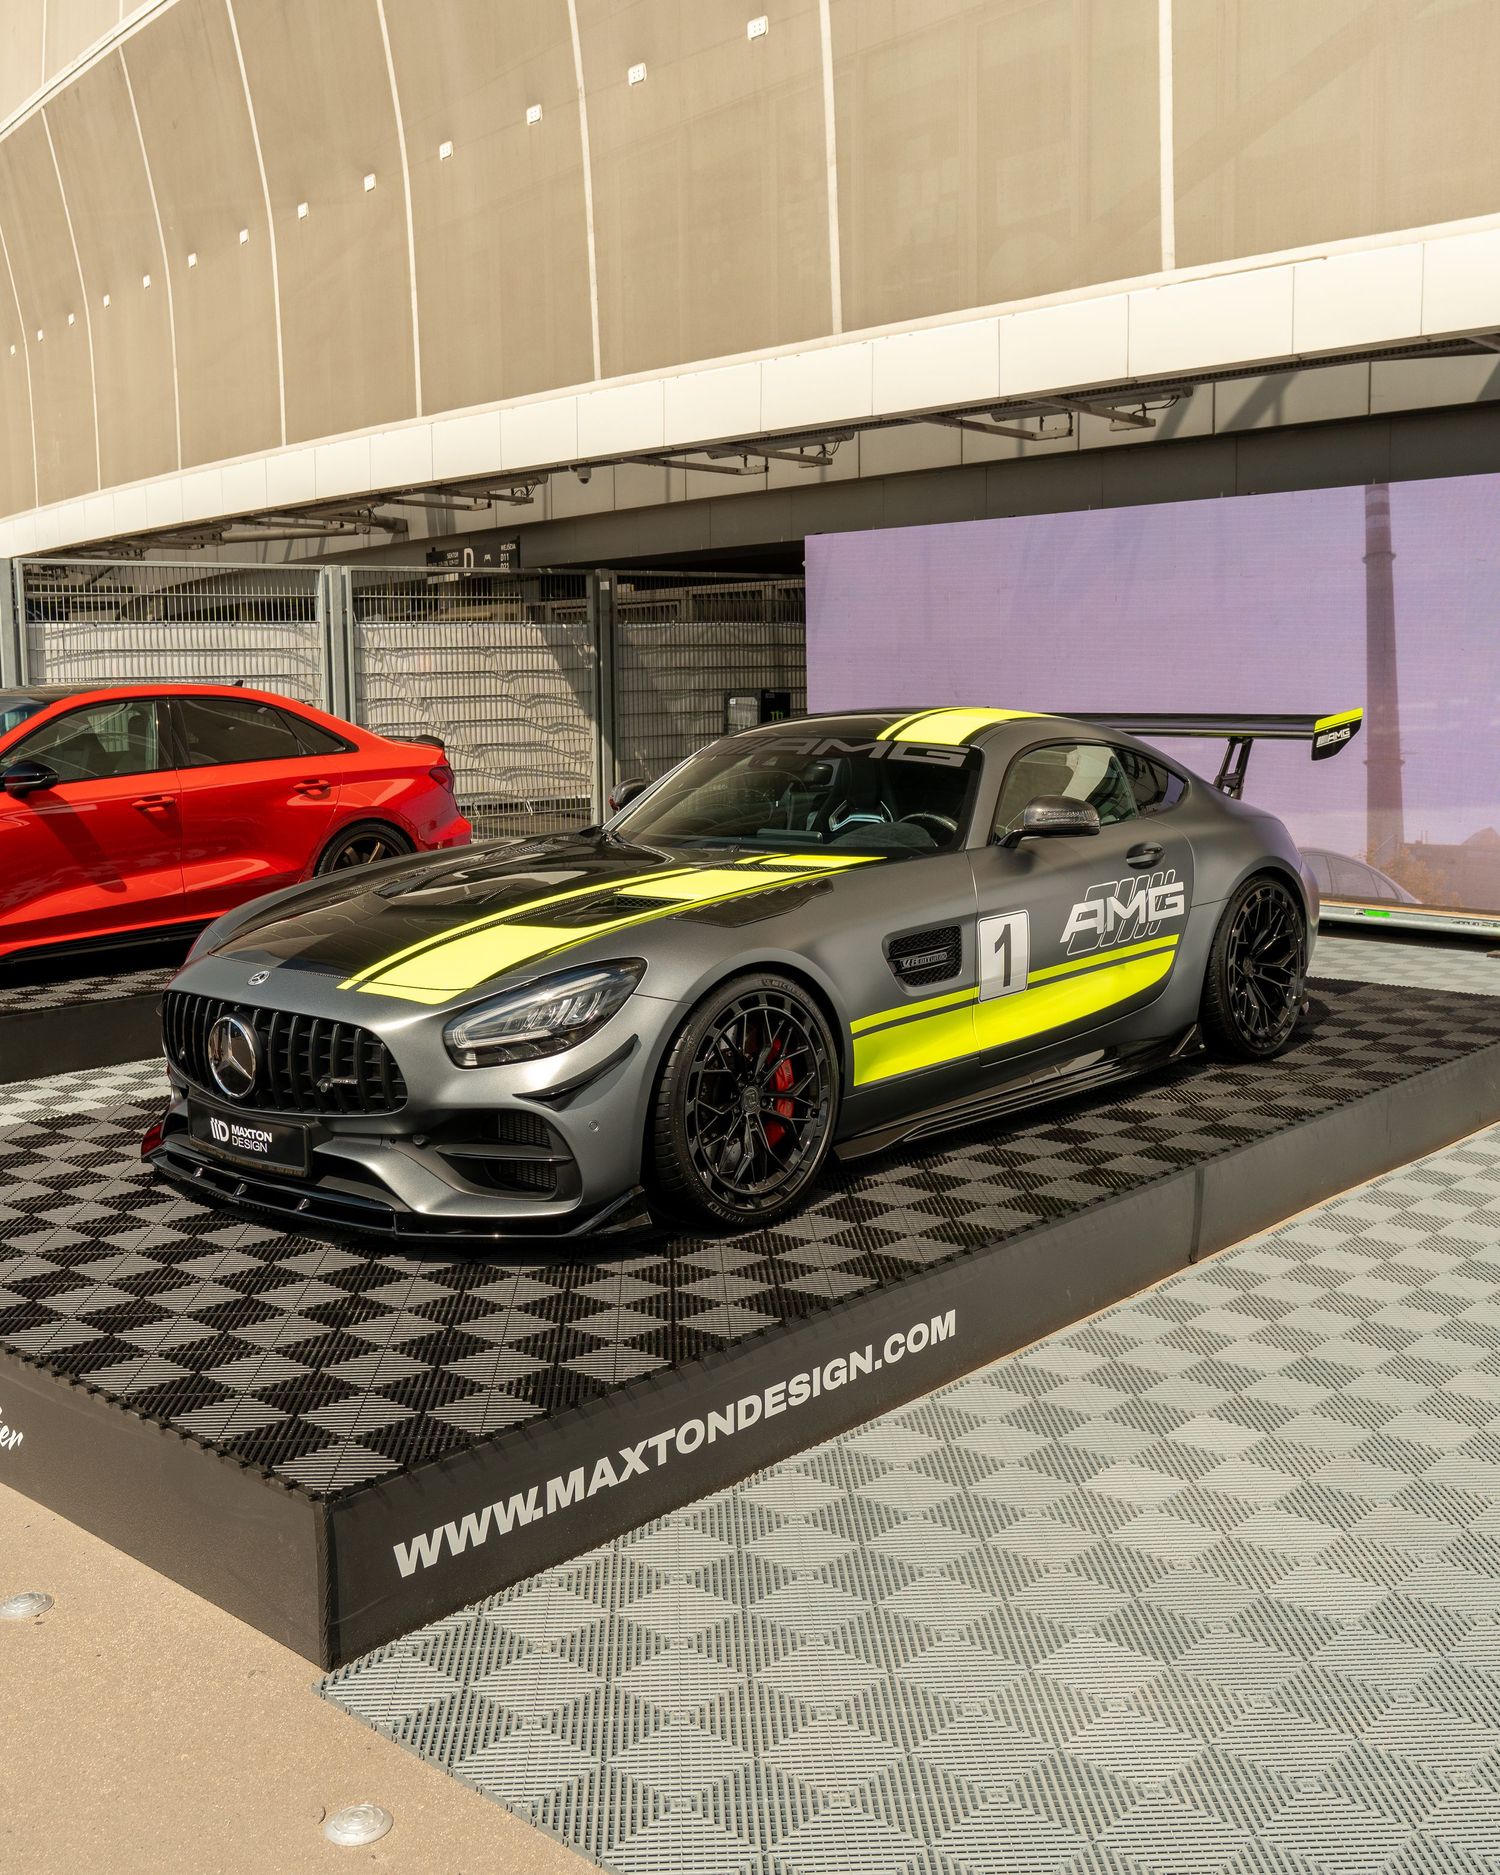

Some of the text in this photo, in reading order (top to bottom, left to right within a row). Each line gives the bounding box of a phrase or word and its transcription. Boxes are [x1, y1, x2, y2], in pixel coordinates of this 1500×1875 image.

[464, 548, 473, 576] D
[1325, 727, 1350, 743] AMG
[738, 737, 970, 768] AMG
[1059, 881, 1185, 944] AMG
[994, 923, 1011, 988] 1
[231, 1124, 273, 1143] MAXTON
[231, 1135, 268, 1153] DESIGN
[393, 1310, 957, 1578] WWW.MAXTONDESIGN.COM
